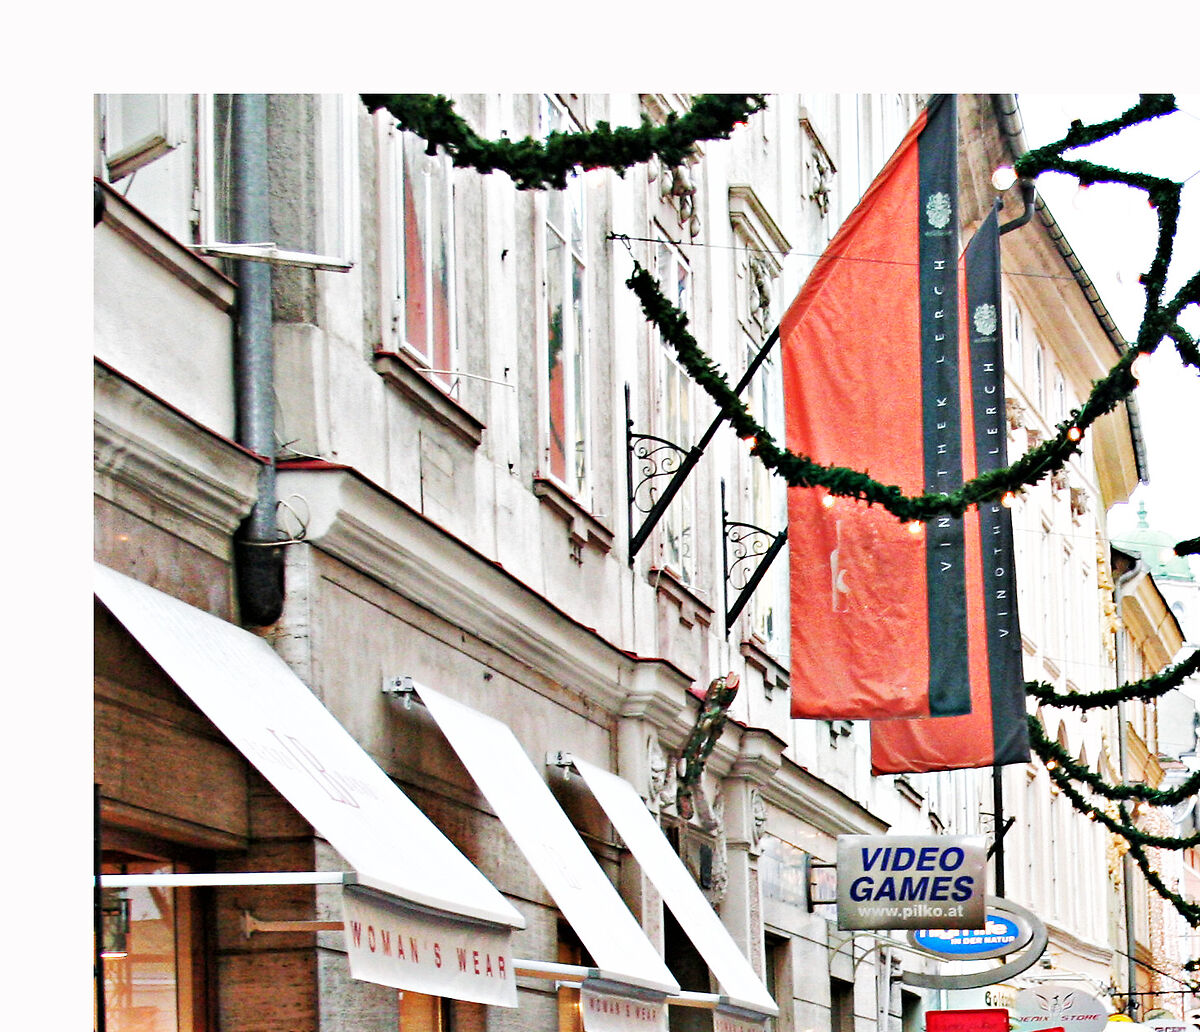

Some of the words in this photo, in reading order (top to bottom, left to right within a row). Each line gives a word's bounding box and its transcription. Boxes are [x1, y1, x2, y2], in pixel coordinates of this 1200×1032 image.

[933, 259, 946, 364] LERCH
[983, 362, 1000, 455] LERCH
[936, 397, 952, 573] VINTHEK
[991, 505, 1010, 639] VINOTHE
[861, 847, 965, 872] VIDEO
[849, 876, 975, 902] GAMES
[857, 904, 965, 920] www.pilko.at
[984, 935, 1015, 944] NATUR
[456, 947, 506, 980] WEAR
